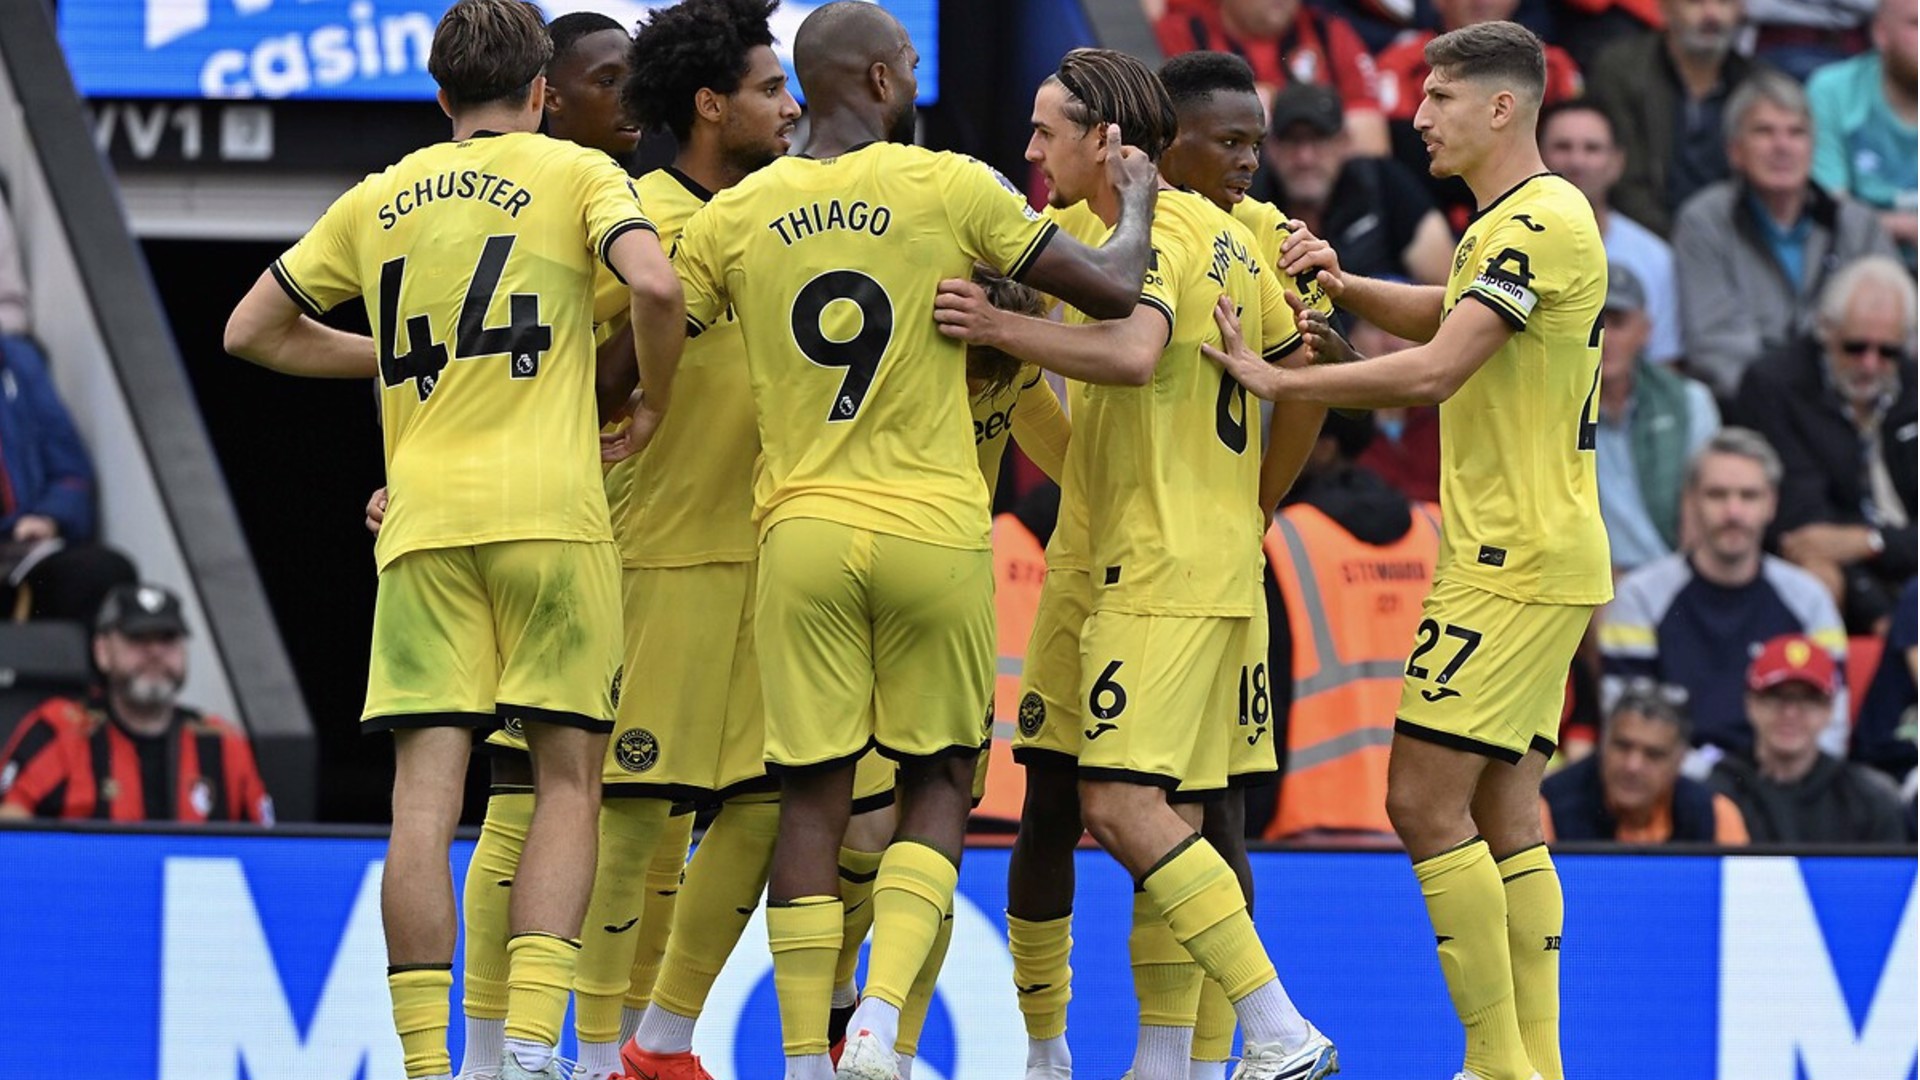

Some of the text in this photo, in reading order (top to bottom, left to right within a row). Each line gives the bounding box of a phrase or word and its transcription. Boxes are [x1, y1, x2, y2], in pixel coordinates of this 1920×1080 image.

[377, 169, 533, 231] SCHUSTER
[767, 199, 892, 246] THIAGO
[378, 234, 554, 404] 44
[790, 269, 895, 423] 9
[1405, 617, 1484, 686] 27
[1088, 659, 1128, 721] 6
[1238, 661, 1270, 727] 18
